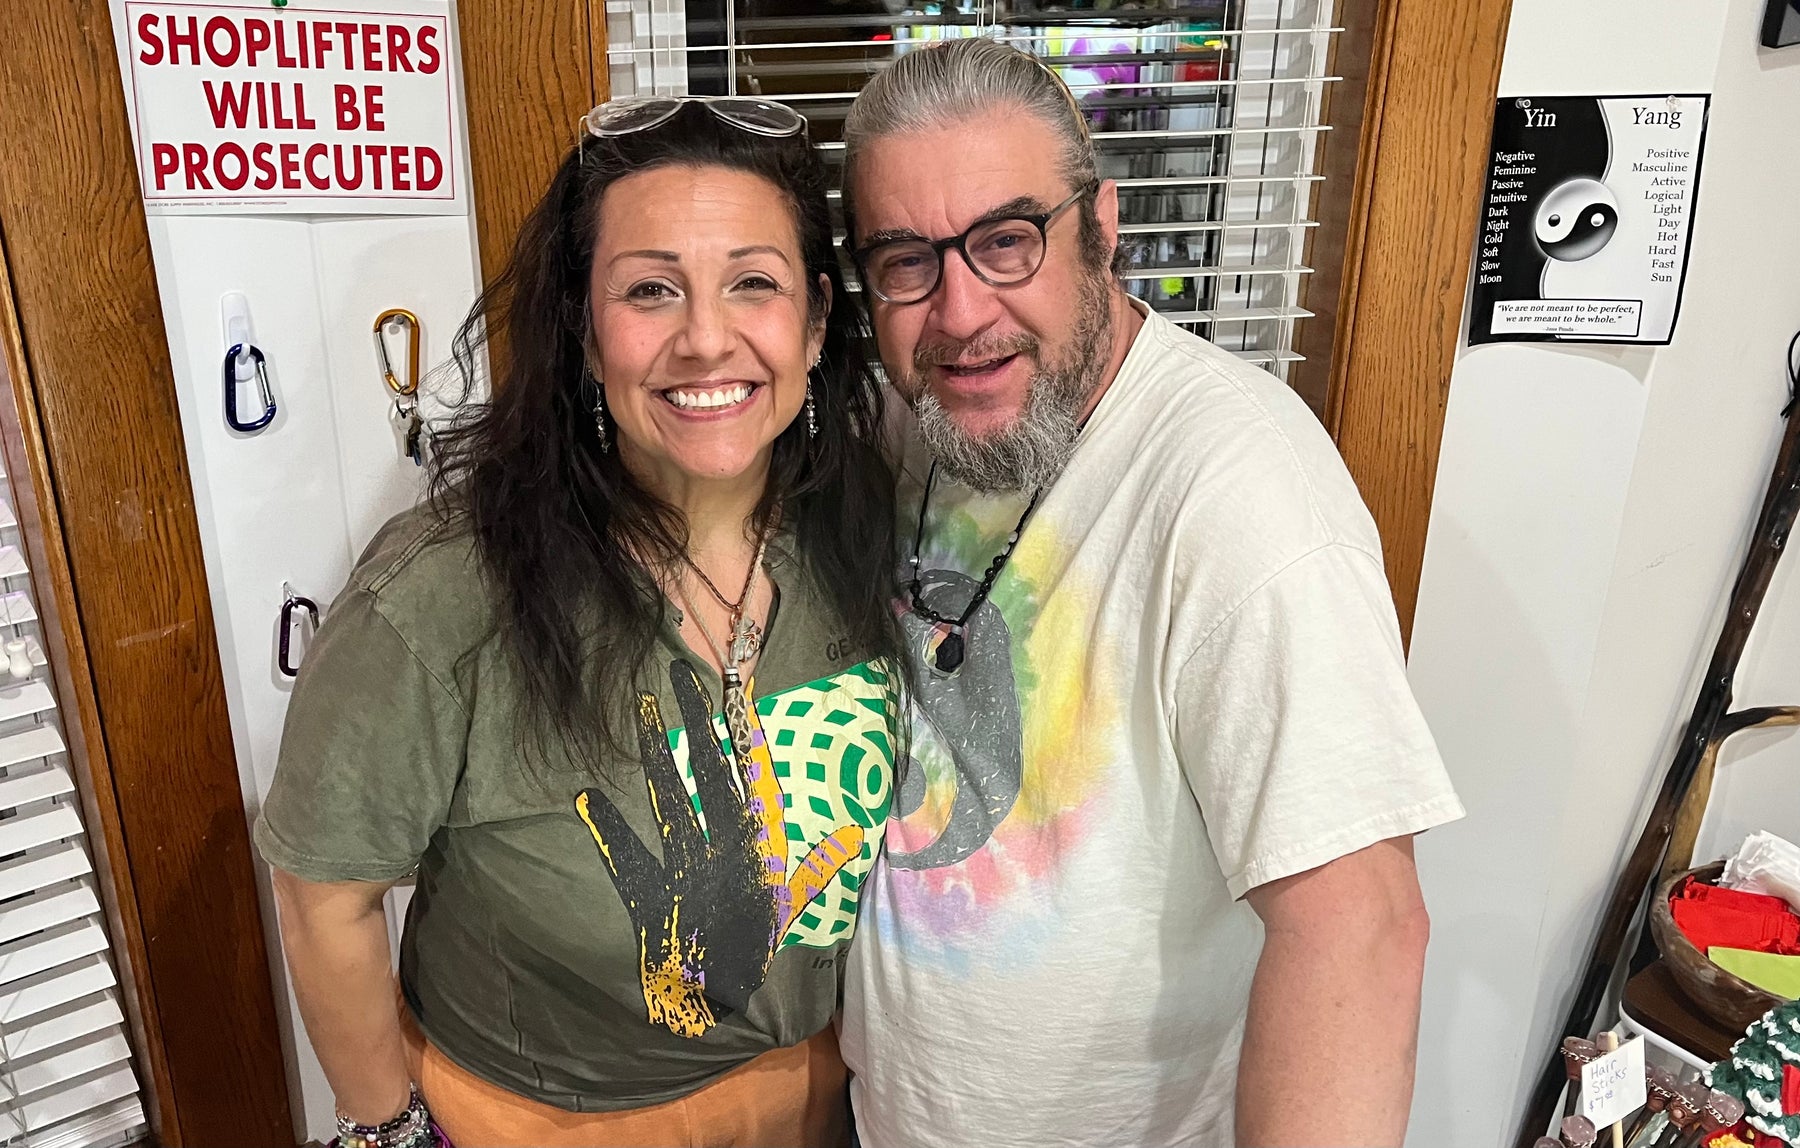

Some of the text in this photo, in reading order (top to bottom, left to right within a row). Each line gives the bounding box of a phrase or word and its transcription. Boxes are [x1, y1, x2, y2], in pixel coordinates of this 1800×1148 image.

[137, 13, 441, 75] SHOPLIFTERS
[202, 80, 385, 131] WILL BE
[1524, 108, 1557, 128] Yin
[1632, 107, 1683, 129] Yang
[1495, 150, 1536, 164] Negative
[1647, 148, 1690, 158] Positive
[152, 141, 443, 191] PROSECUTED
[1493, 164, 1537, 176] Feminine
[1632, 161, 1688, 172] Masculine
[1491, 178, 1524, 190] Passive
[1650, 176, 1686, 186] Active
[1489, 191, 1528, 204] Intuitive
[1644, 189, 1684, 203] Logical
[1488, 205, 1509, 217] Dark
[1653, 203, 1682, 217] Light
[1486, 219, 1510, 233] Night
[1658, 217, 1681, 230] Day
[1484, 232, 1504, 244] Cold
[1657, 231, 1678, 241] Hot
[1482, 246, 1499, 258] Soft
[1648, 244, 1677, 255] Hard
[1480, 260, 1501, 271] Slow
[1651, 258, 1675, 269] Fast
[1479, 273, 1502, 285] Moon
[1650, 272, 1673, 282] Sun
[1529, 304, 1544, 312] not
[1546, 304, 1574, 312] meant
[1576, 304, 1585, 312] to
[1587, 304, 1598, 313] be
[1599, 304, 1635, 314] perfect,
[1533, 315, 1561, 323] meant
[1563, 315, 1572, 323] to
[1574, 315, 1586, 323] be
[1591, 1060, 1616, 1079] Hair
[1591, 1067, 1627, 1094] Sticks
